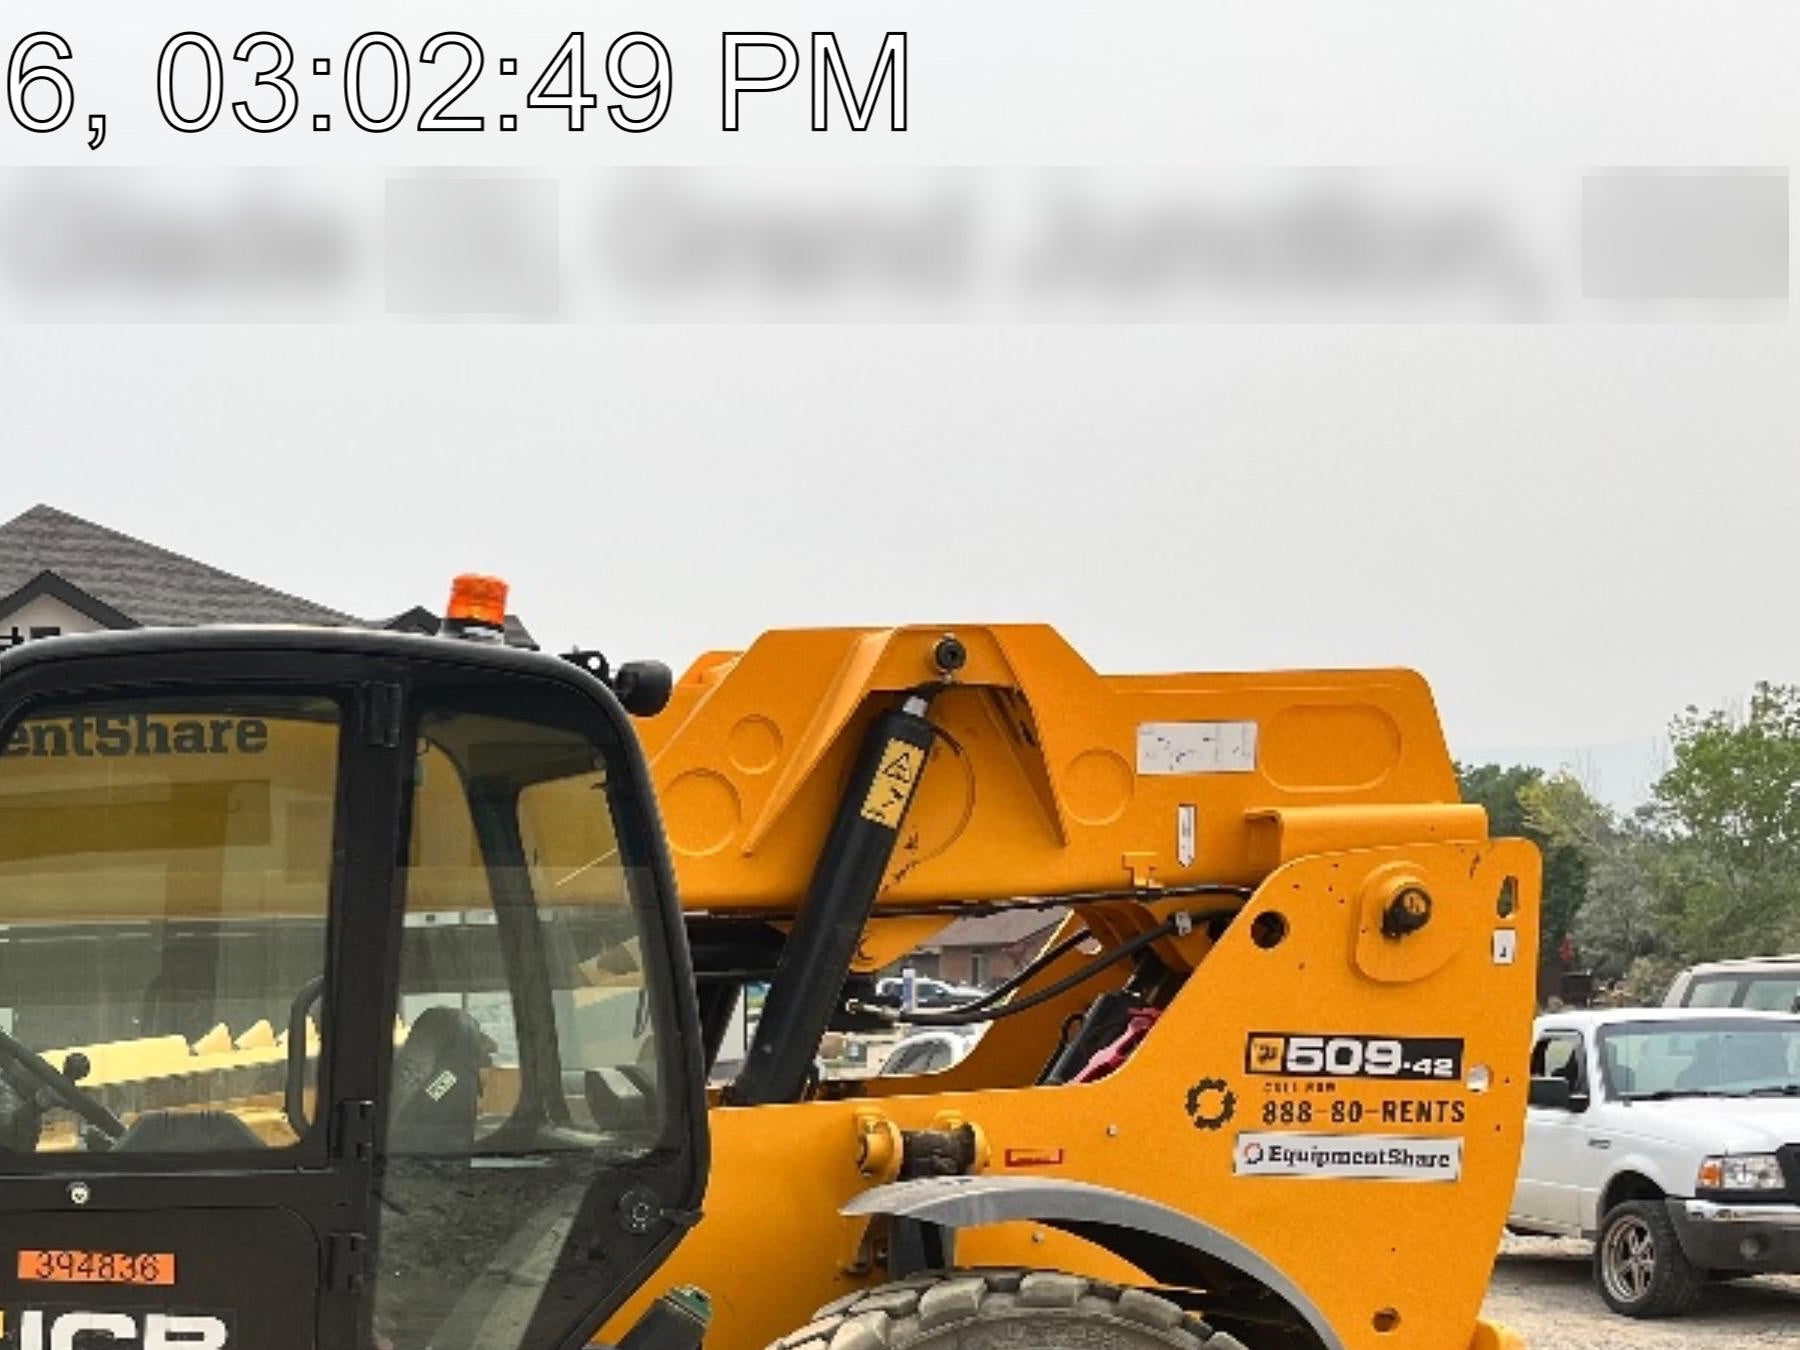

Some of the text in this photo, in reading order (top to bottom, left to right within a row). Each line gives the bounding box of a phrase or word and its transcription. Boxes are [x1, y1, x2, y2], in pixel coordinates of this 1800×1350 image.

[1262, 1100, 1466, 1124] 888-80-RENTS
[1268, 1145, 1451, 1168] EquipmentShare
[35, 1251, 160, 1281] 394836
